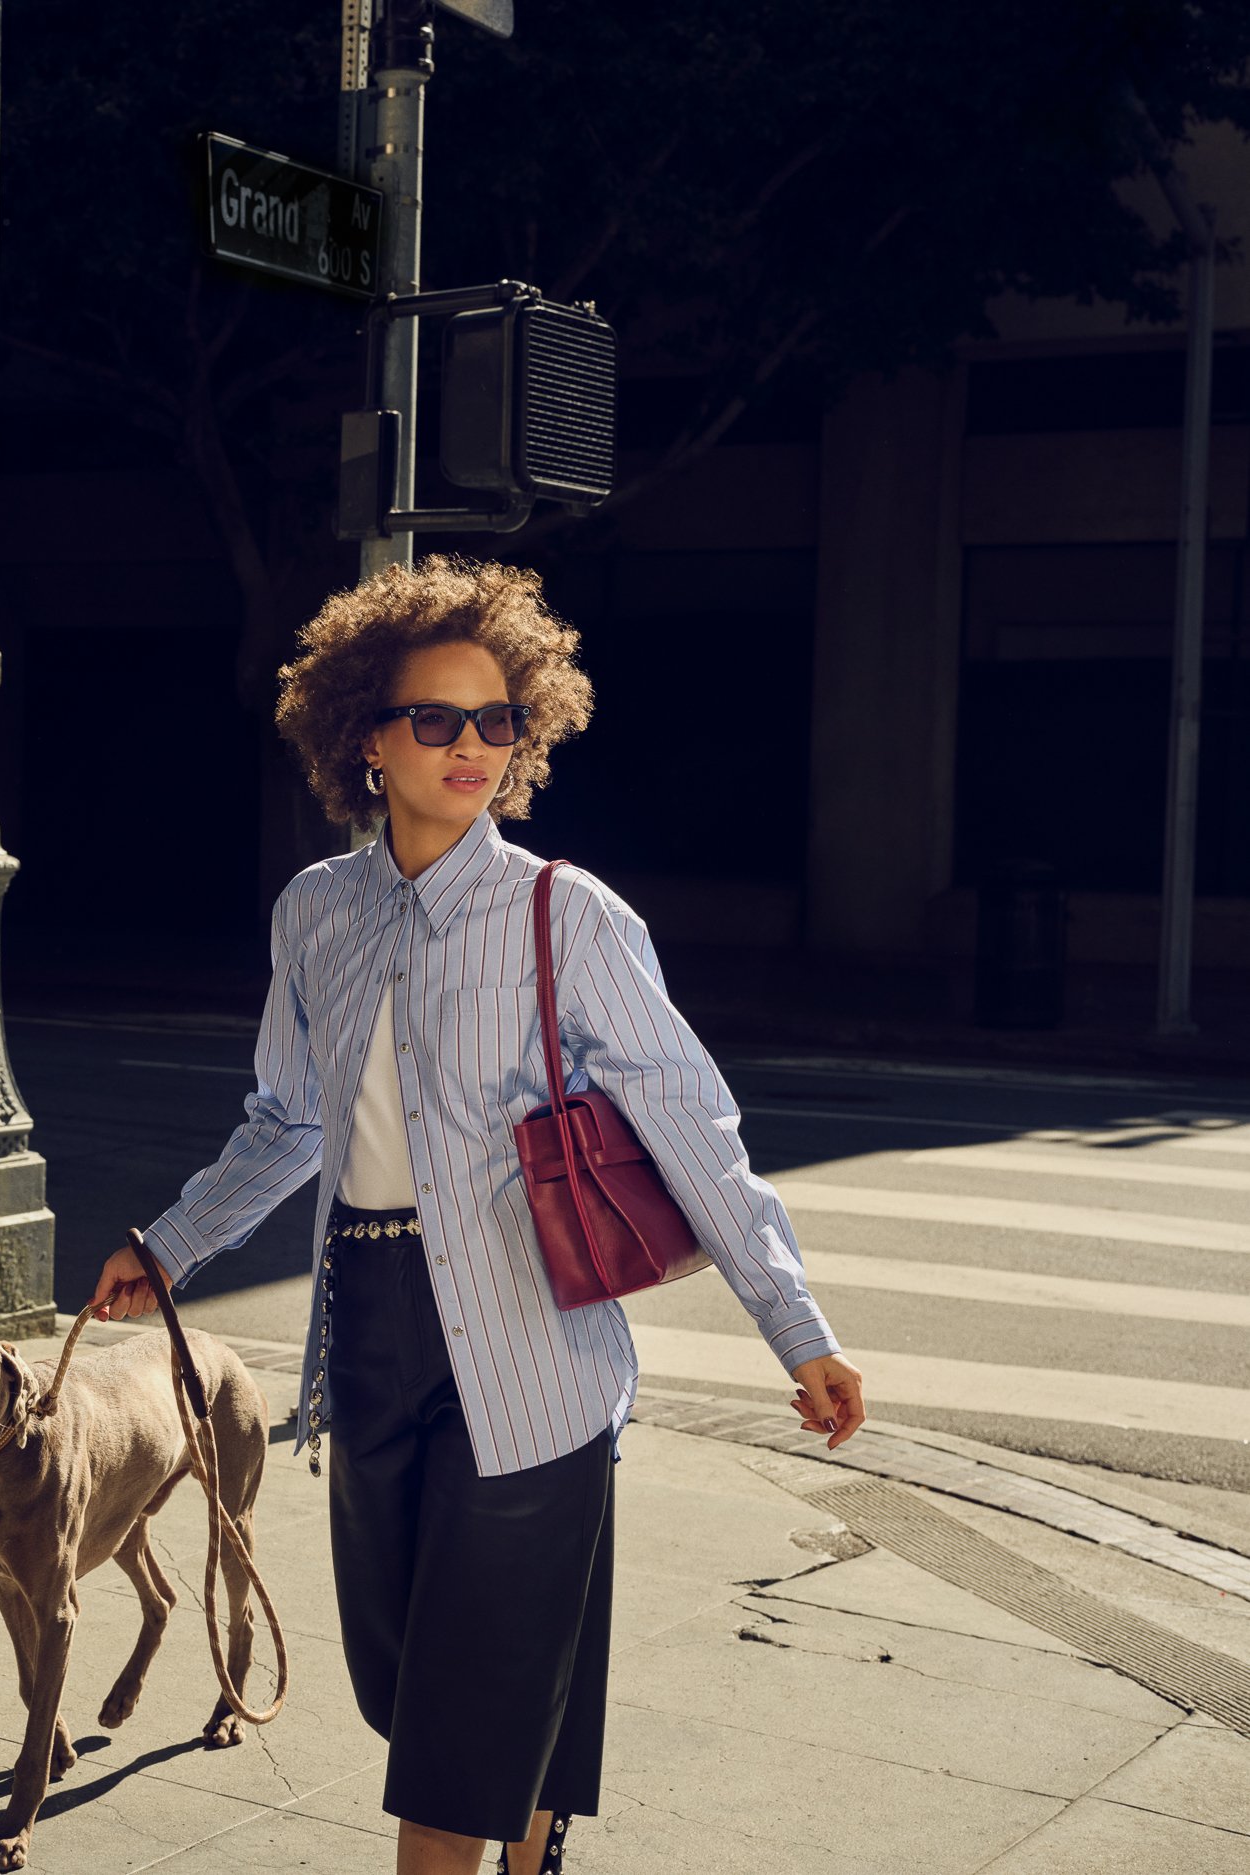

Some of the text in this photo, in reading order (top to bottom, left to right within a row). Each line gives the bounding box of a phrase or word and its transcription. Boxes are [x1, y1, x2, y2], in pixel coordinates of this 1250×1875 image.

[221, 167, 300, 244] Grand
[318, 240, 371, 286] 600 S
